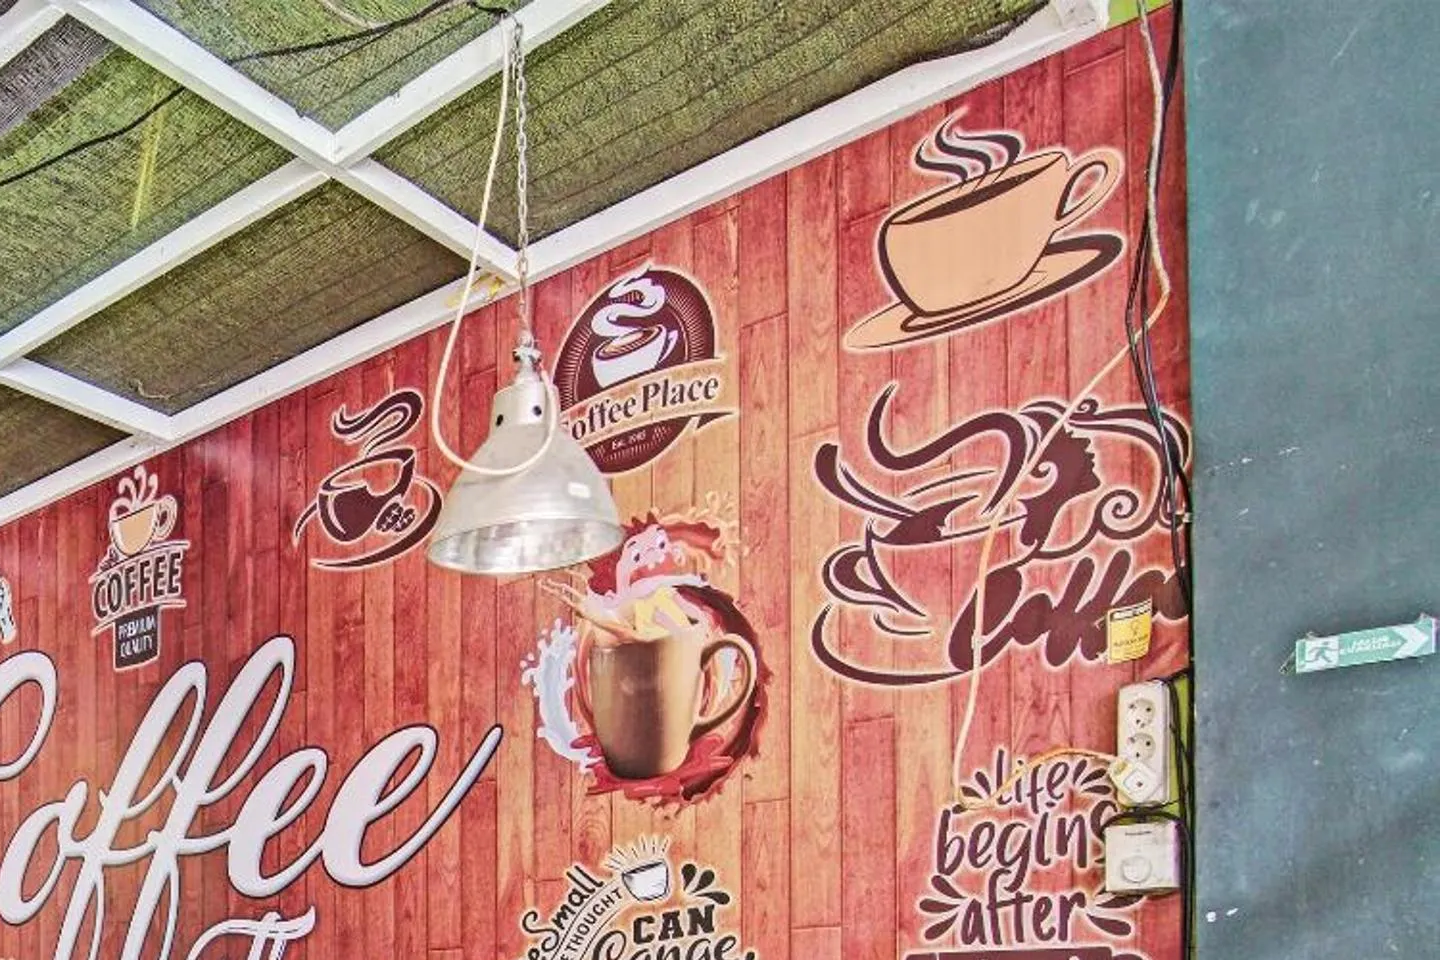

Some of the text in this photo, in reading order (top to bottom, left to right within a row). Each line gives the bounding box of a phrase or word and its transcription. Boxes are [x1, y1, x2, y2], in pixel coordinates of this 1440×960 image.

[560, 375, 720, 441] offee Place
[93, 551, 182, 619] COFFEE
[521, 865, 605, 953] Small
[565, 886, 625, 954] THOUGHT
[633, 903, 718, 945] CAN
[960, 867, 1088, 946] after
